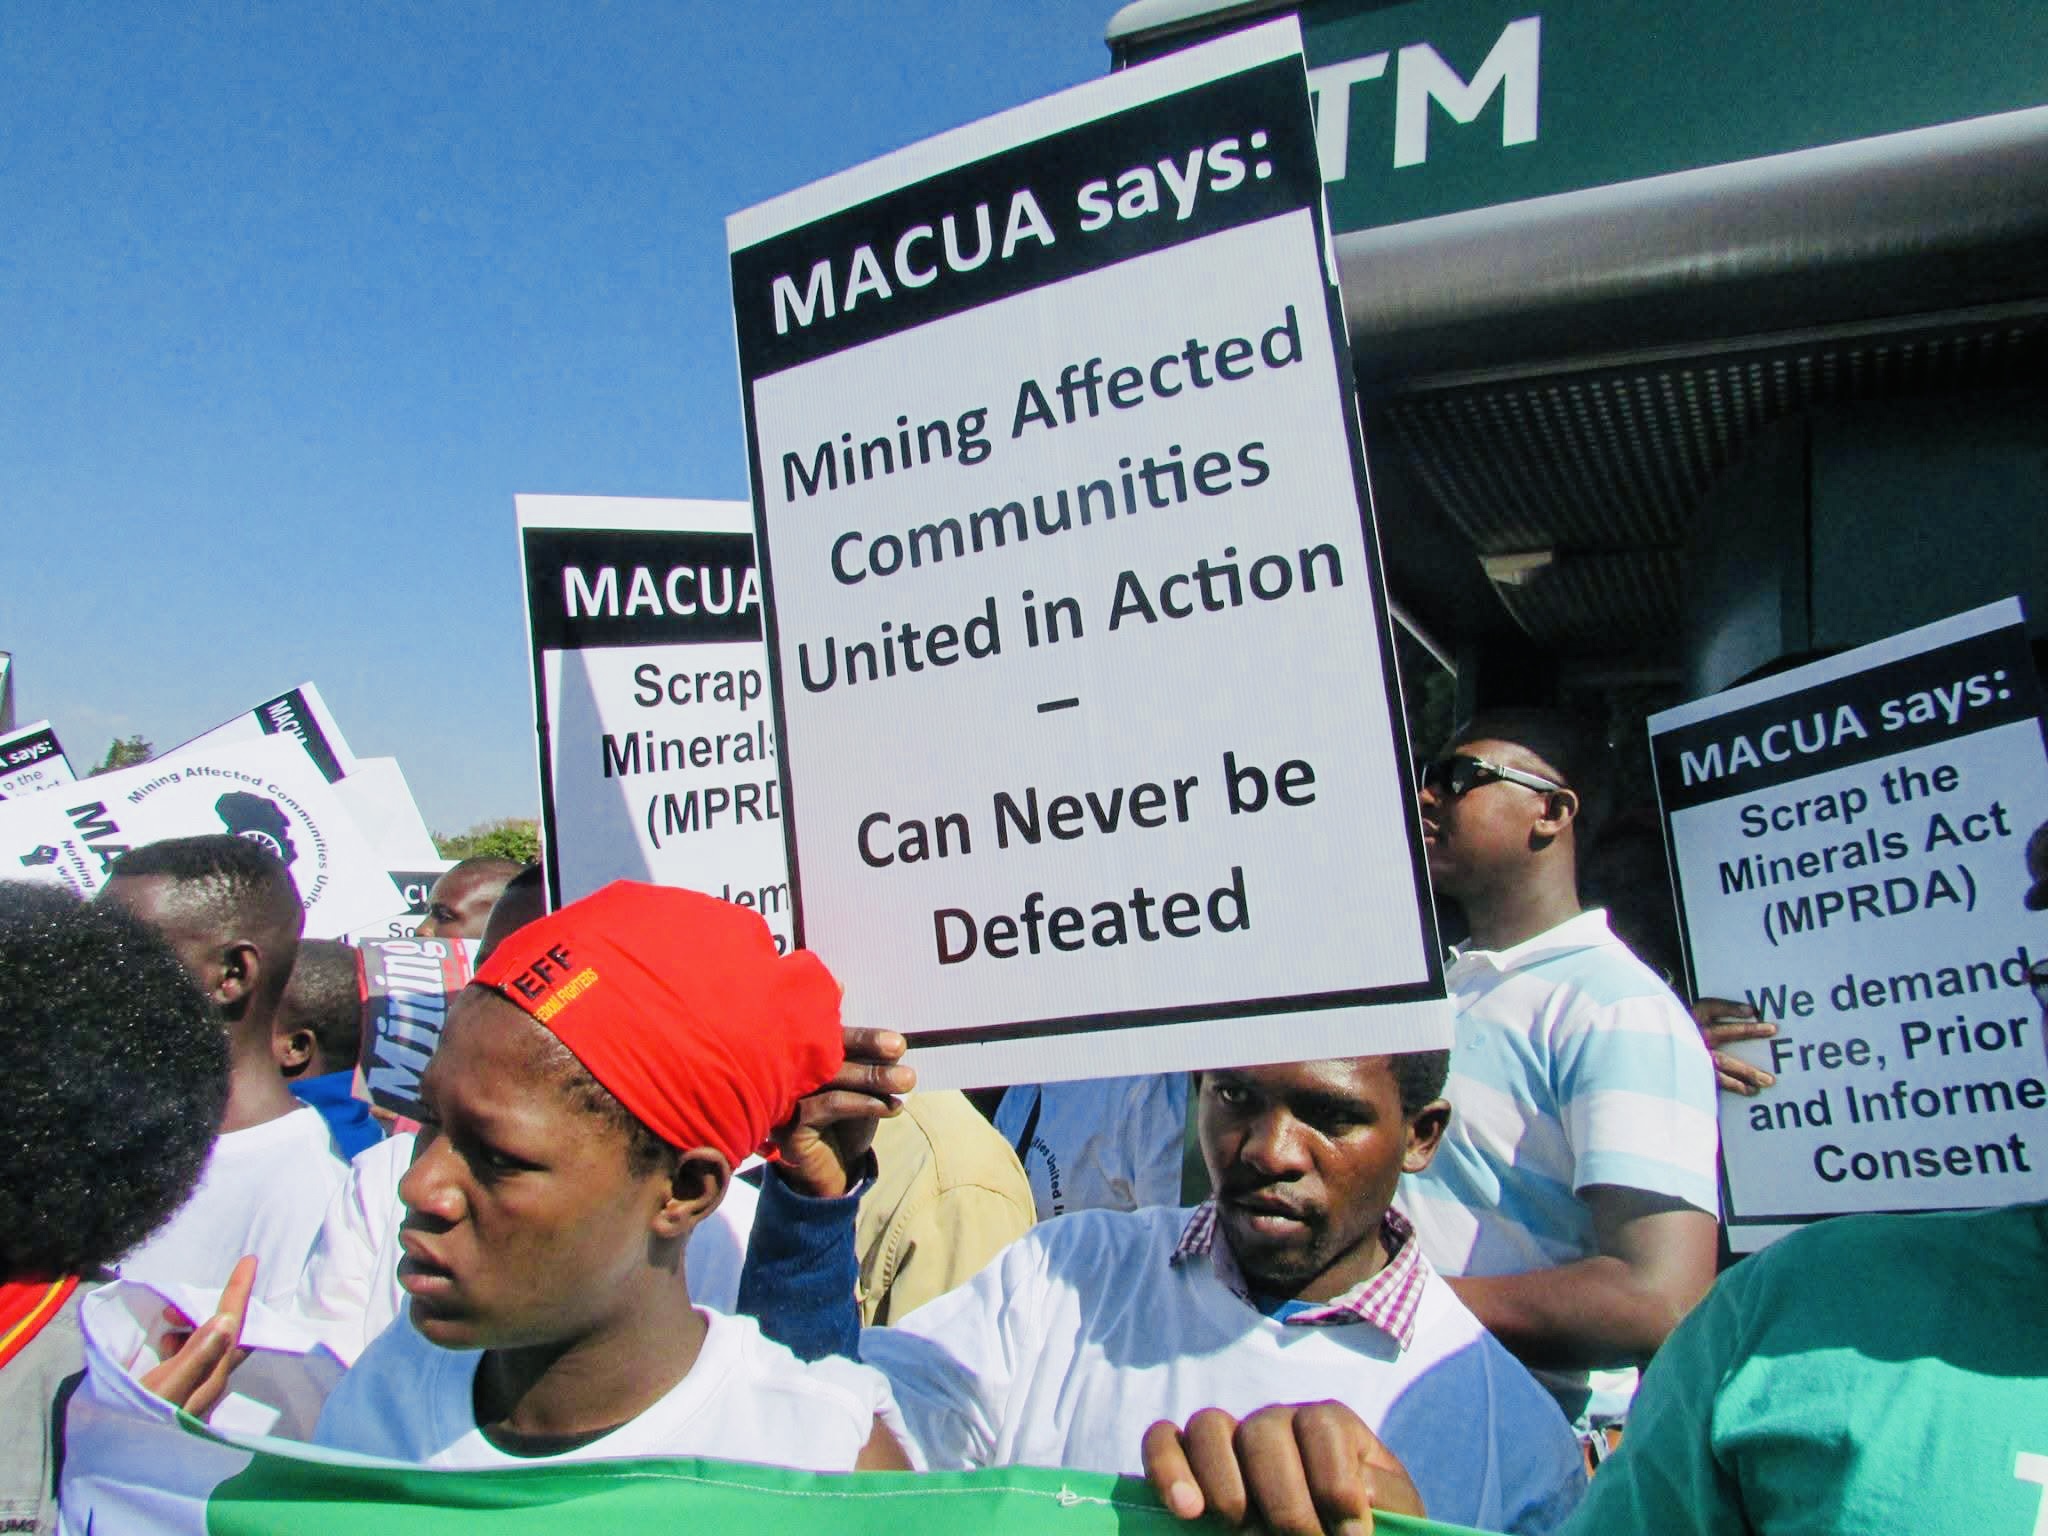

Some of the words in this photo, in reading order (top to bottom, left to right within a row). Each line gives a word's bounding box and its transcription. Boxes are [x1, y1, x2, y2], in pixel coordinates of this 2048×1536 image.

[1306, 15, 1541, 183] TM
[771, 189, 1056, 335] MACUA
[1077, 130, 1274, 232] says:
[783, 408, 992, 502] Mining
[1012, 305, 1303, 438] Affected
[830, 440, 1270, 585] Communities
[799, 597, 1001, 693] United
[1023, 590, 1083, 647] in
[1108, 542, 1343, 631] Action
[634, 664, 761, 711] Scrap
[1680, 704, 1867, 786] MACUA
[1880, 669, 2011, 730] says:
[8, 740, 53, 765] says:
[127, 772, 181, 805] Mining
[185, 766, 262, 787] Affected
[267, 784, 330, 869] Communities
[302, 874, 329, 910] Unite
[857, 811, 971, 868] Can
[993, 776, 1198, 849] Never
[1223, 751, 1316, 815] be
[1719, 828, 1908, 895] Minerals
[1925, 801, 2011, 853] Act
[1741, 787, 1867, 838] Scrap
[1880, 764, 1959, 805] the
[933, 866, 1250, 964] Defeated
[1764, 864, 1976, 946] (MPRDA)
[366, 938, 448, 1102] Mining
[512, 943, 571, 1001] EFF
[1745, 985, 1814, 1021] We
[1831, 946, 2031, 1011] demand
[1770, 1036, 1885, 1074] Free,
[1901, 1015, 2029, 1060] Prior
[1750, 1090, 1832, 1131] and
[1846, 1076, 2048, 1124] Informe
[1814, 1133, 2031, 1183] Consent
